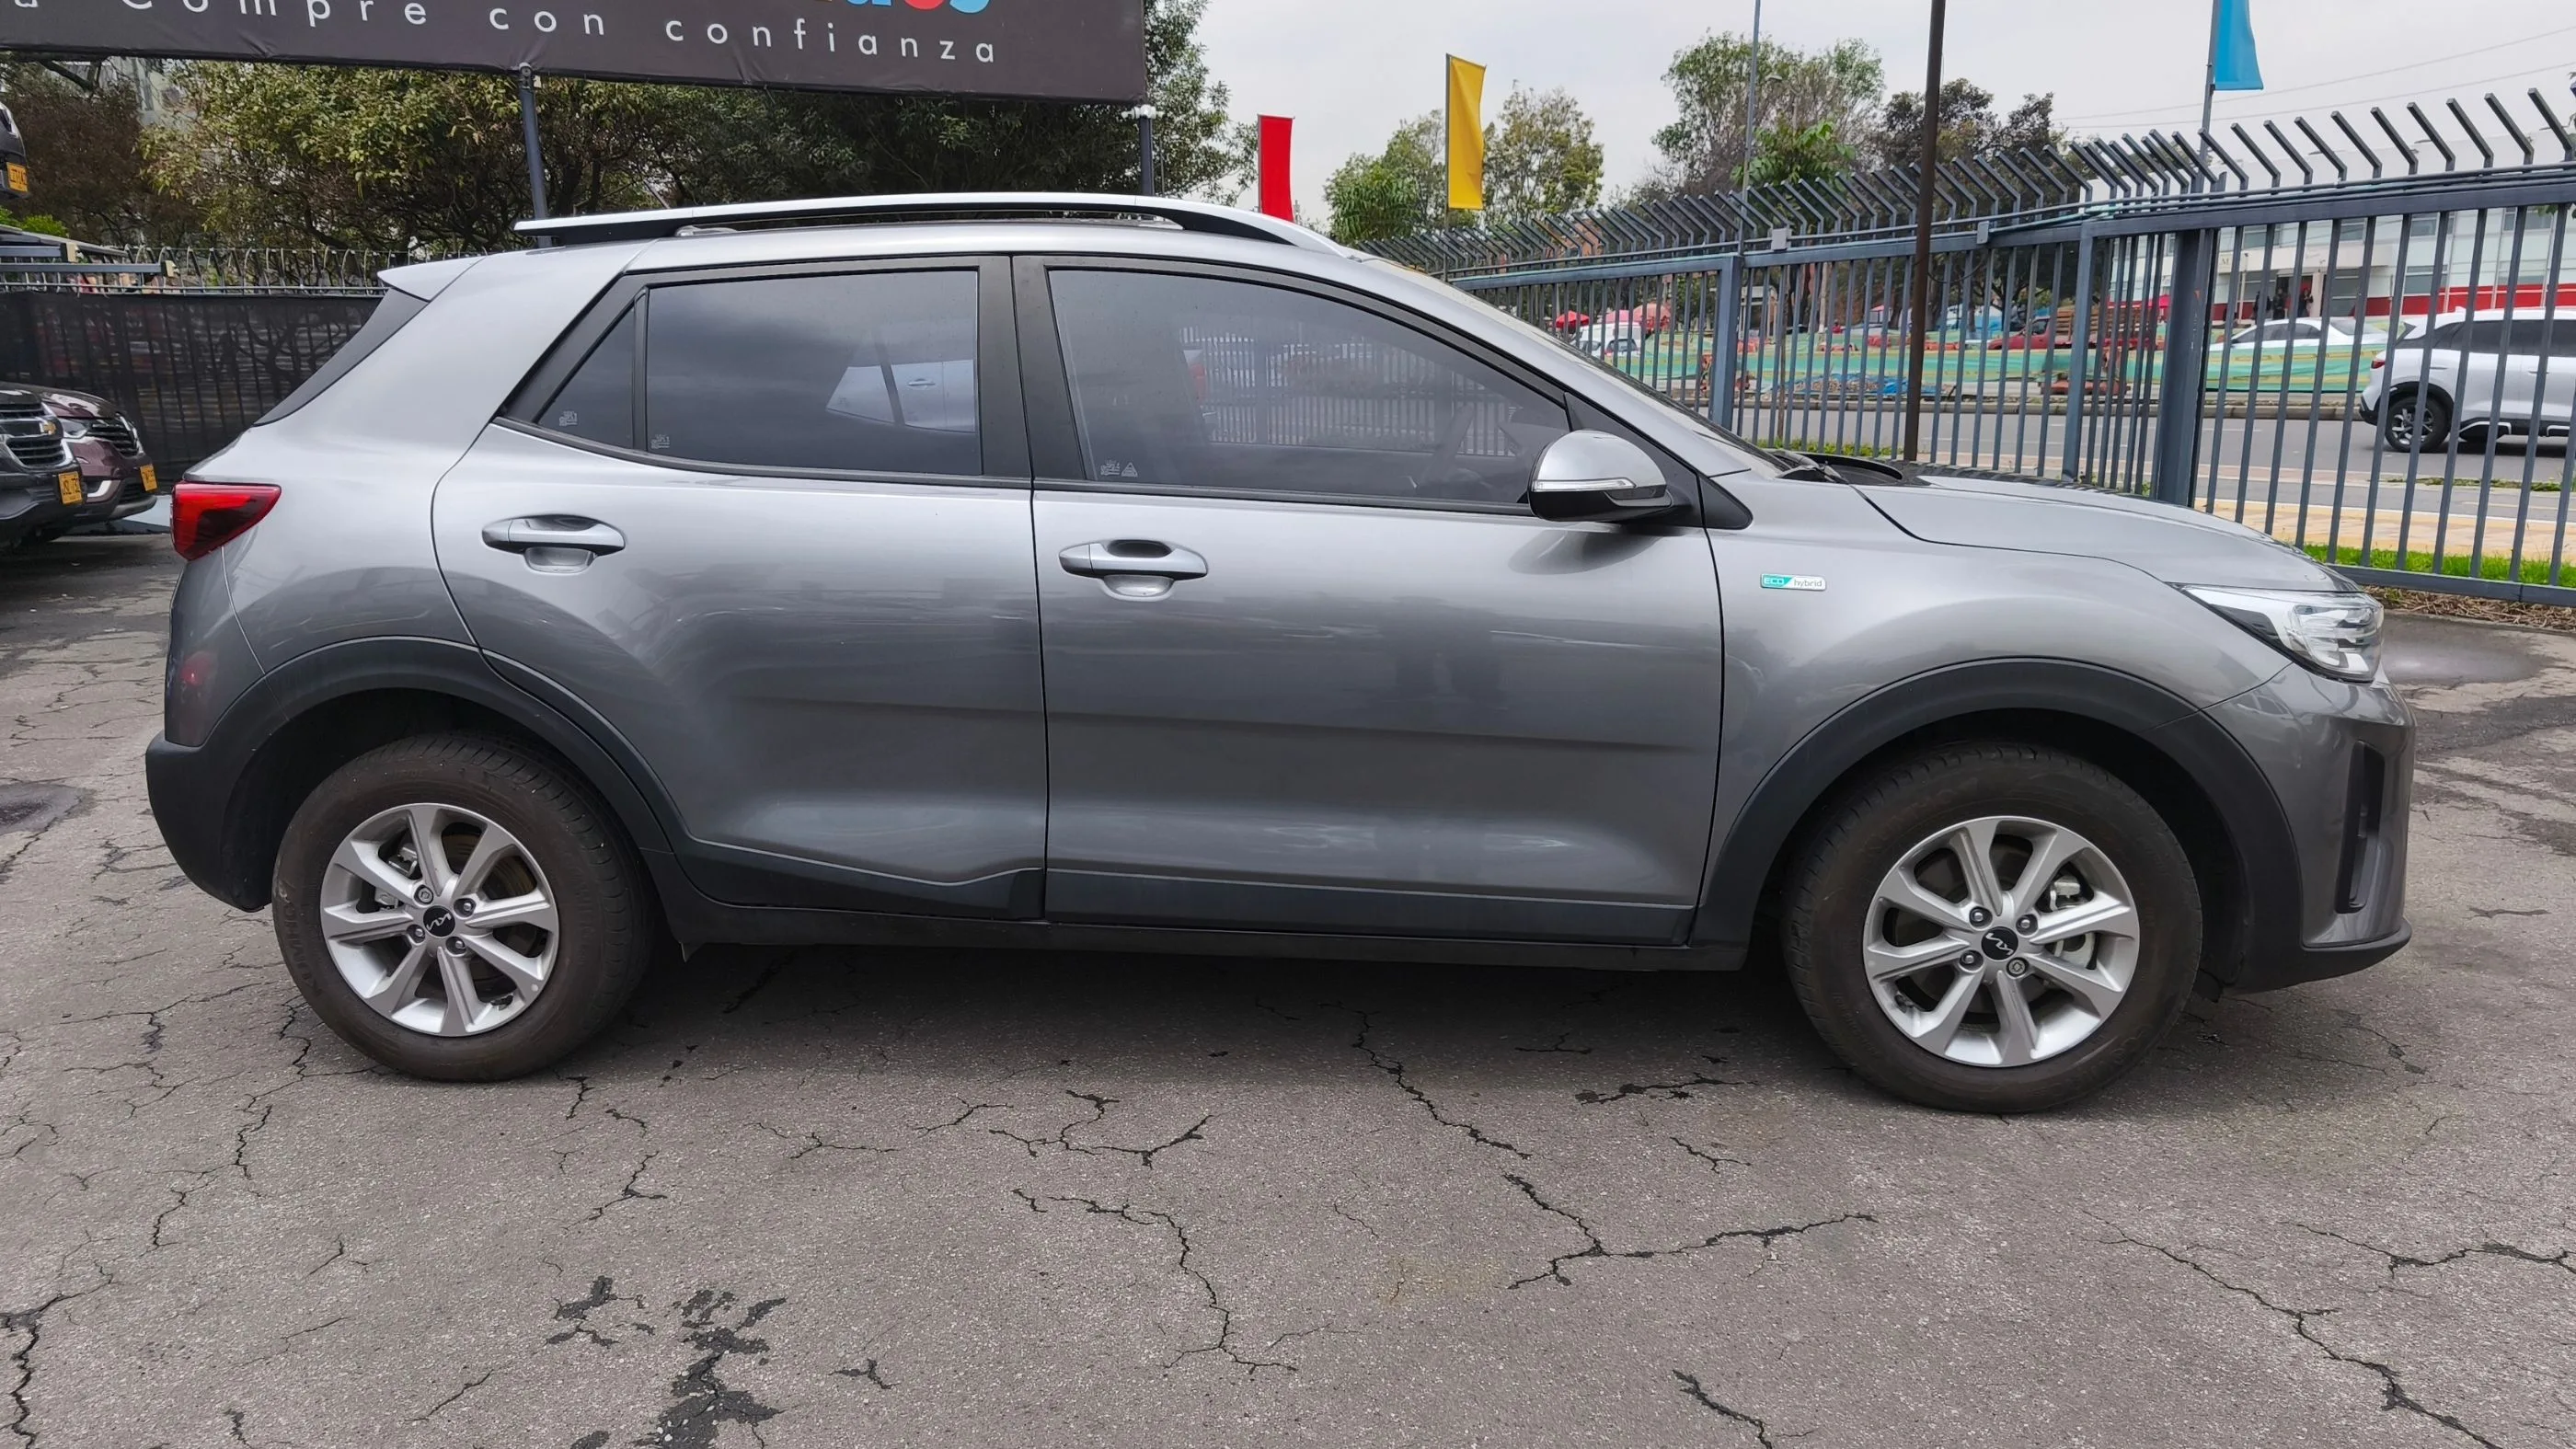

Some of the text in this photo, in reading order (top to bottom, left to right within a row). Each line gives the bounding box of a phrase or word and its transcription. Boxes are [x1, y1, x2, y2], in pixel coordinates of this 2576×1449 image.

[489, 7, 605, 36] con
[665, 18, 995, 63] confianza
[1793, 579, 1823, 588] hybrid
